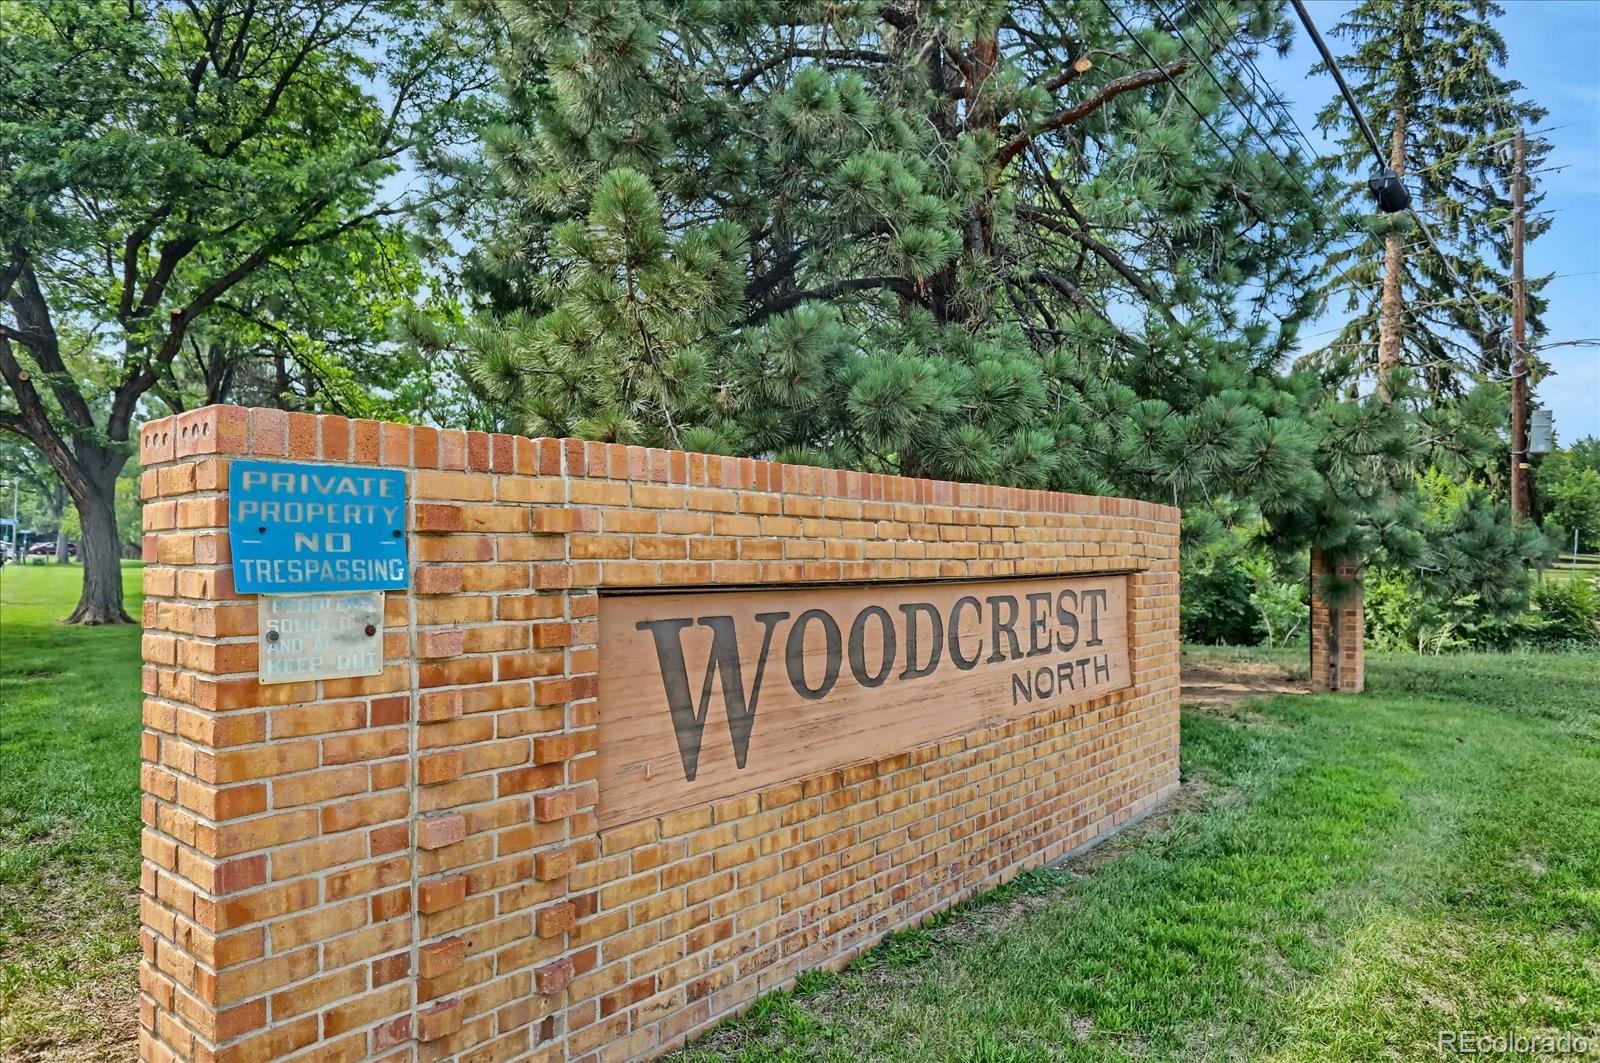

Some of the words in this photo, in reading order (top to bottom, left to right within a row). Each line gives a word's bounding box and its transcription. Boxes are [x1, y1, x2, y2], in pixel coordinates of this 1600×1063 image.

[242, 471, 396, 498] PRIVATE
[238, 500, 399, 525] PROPERTY
[294, 532, 351, 553] NO
[240, 558, 405, 584] TRESPASSING
[635, 588, 1108, 782] WOODCREST
[1011, 653, 1111, 706] NORTH
